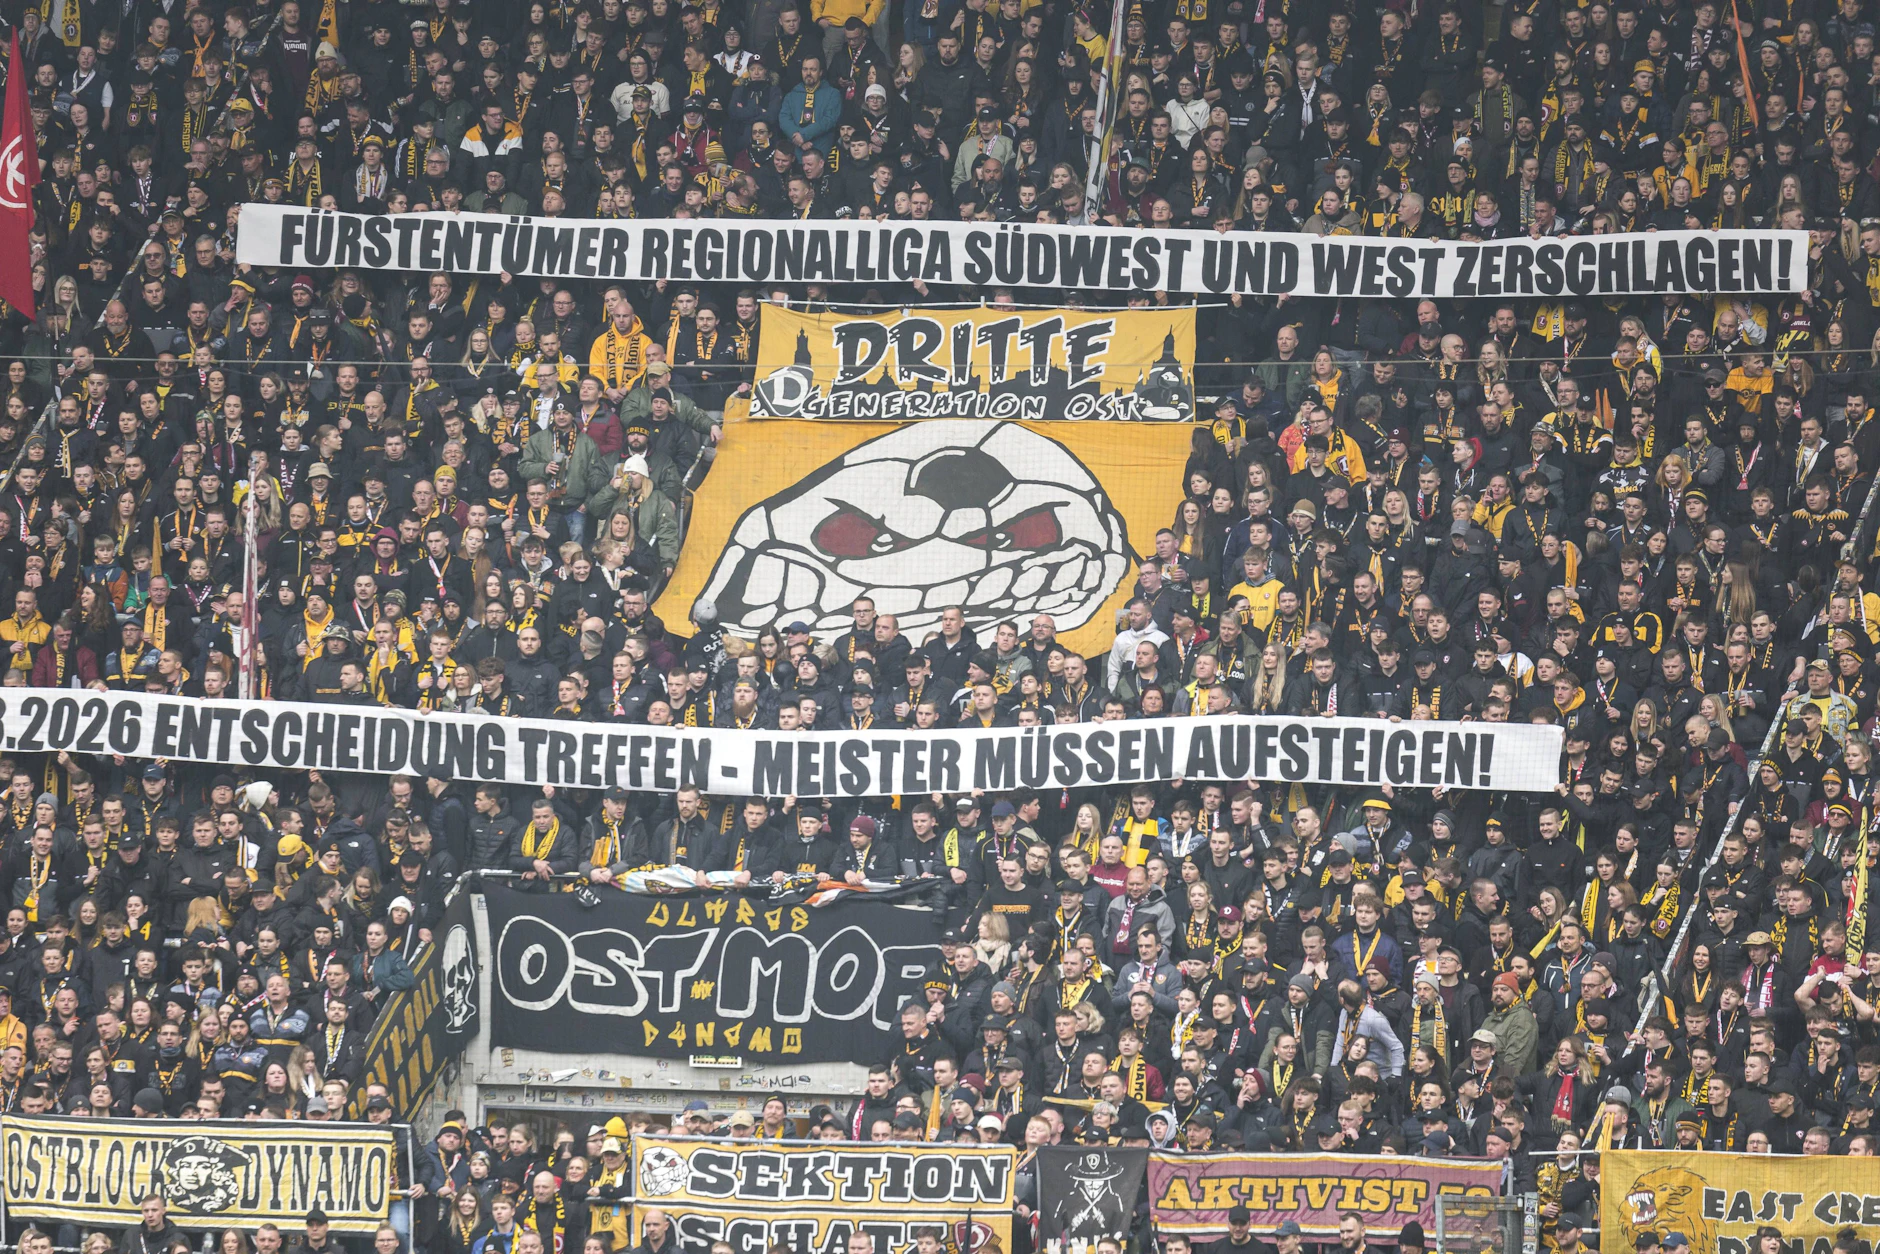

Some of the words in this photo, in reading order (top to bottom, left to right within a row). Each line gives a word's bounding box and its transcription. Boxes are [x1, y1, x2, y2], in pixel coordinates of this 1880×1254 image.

[280, 208, 629, 278] FÜRSTENTÜMER
[640, 228, 952, 281] REGIONALLIGA
[964, 224, 1191, 291] SÜDWEST
[1202, 240, 1298, 293] UND
[1313, 245, 1446, 298] WEST
[1453, 238, 1791, 298] ZERSCHLAGEN!
[832, 315, 1118, 390] DRITTE
[800, 386, 1047, 421] GENERATION
[1064, 391, 1142, 422] OST
[0, 696, 141, 754] .2026
[151, 703, 505, 780] ENTSCHEIDUNG
[518, 726, 711, 790] TREFFEN
[721, 765, 739, 779] -
[752, 738, 962, 796] MEISTER
[974, 725, 1177, 790] MÜSSEN
[1186, 723, 1496, 787] AUFSTEIGEN!
[239, 1144, 391, 1218] DYNAMO
[685, 1147, 1011, 1203] SEKTION
[1156, 1174, 1428, 1214] AKTIVIST
[1703, 1187, 1803, 1224] EAST
[1814, 1193, 1880, 1228] CRE
